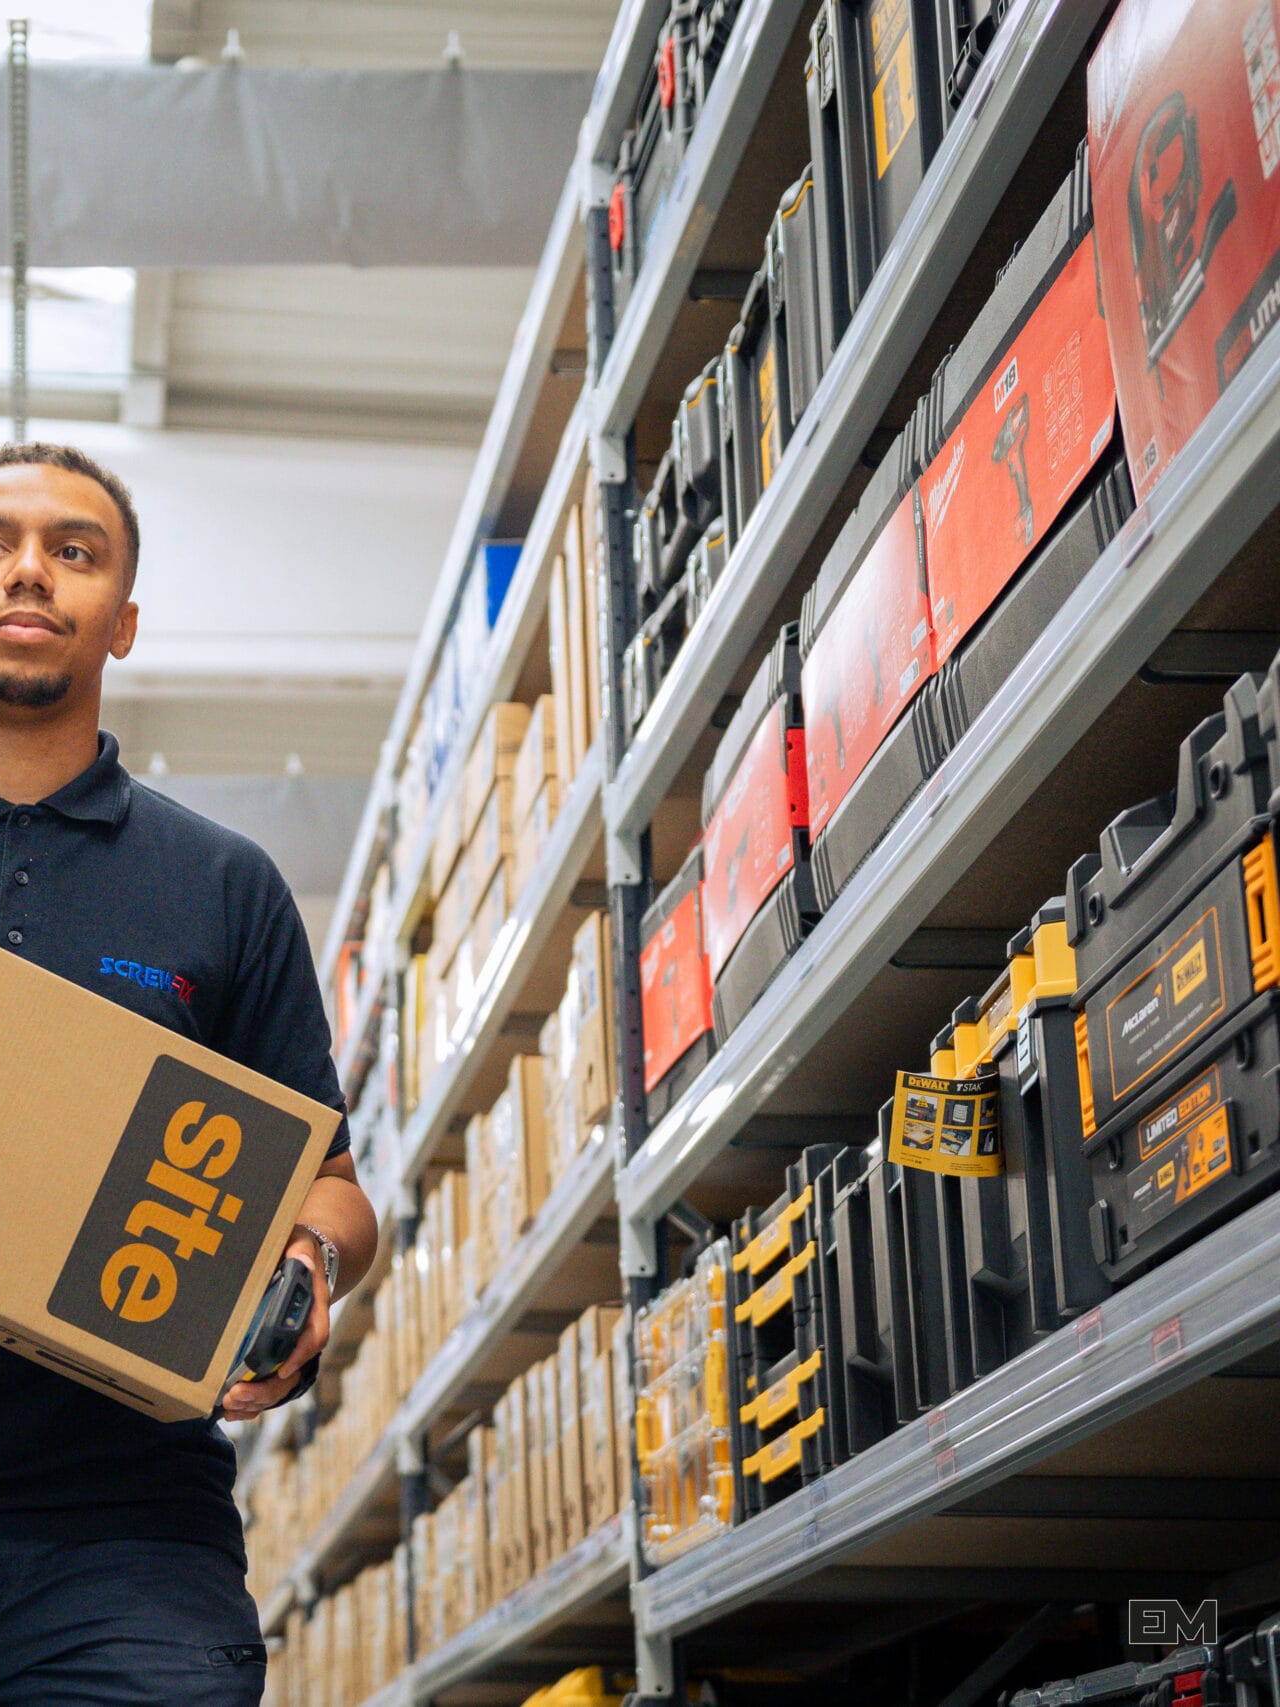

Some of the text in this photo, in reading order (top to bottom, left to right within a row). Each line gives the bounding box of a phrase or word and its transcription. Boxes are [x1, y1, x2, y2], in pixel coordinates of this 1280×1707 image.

[995, 364, 1017, 409] M18
[1146, 1107, 1179, 1143] LIMITED
[100, 1101, 244, 1323] site
